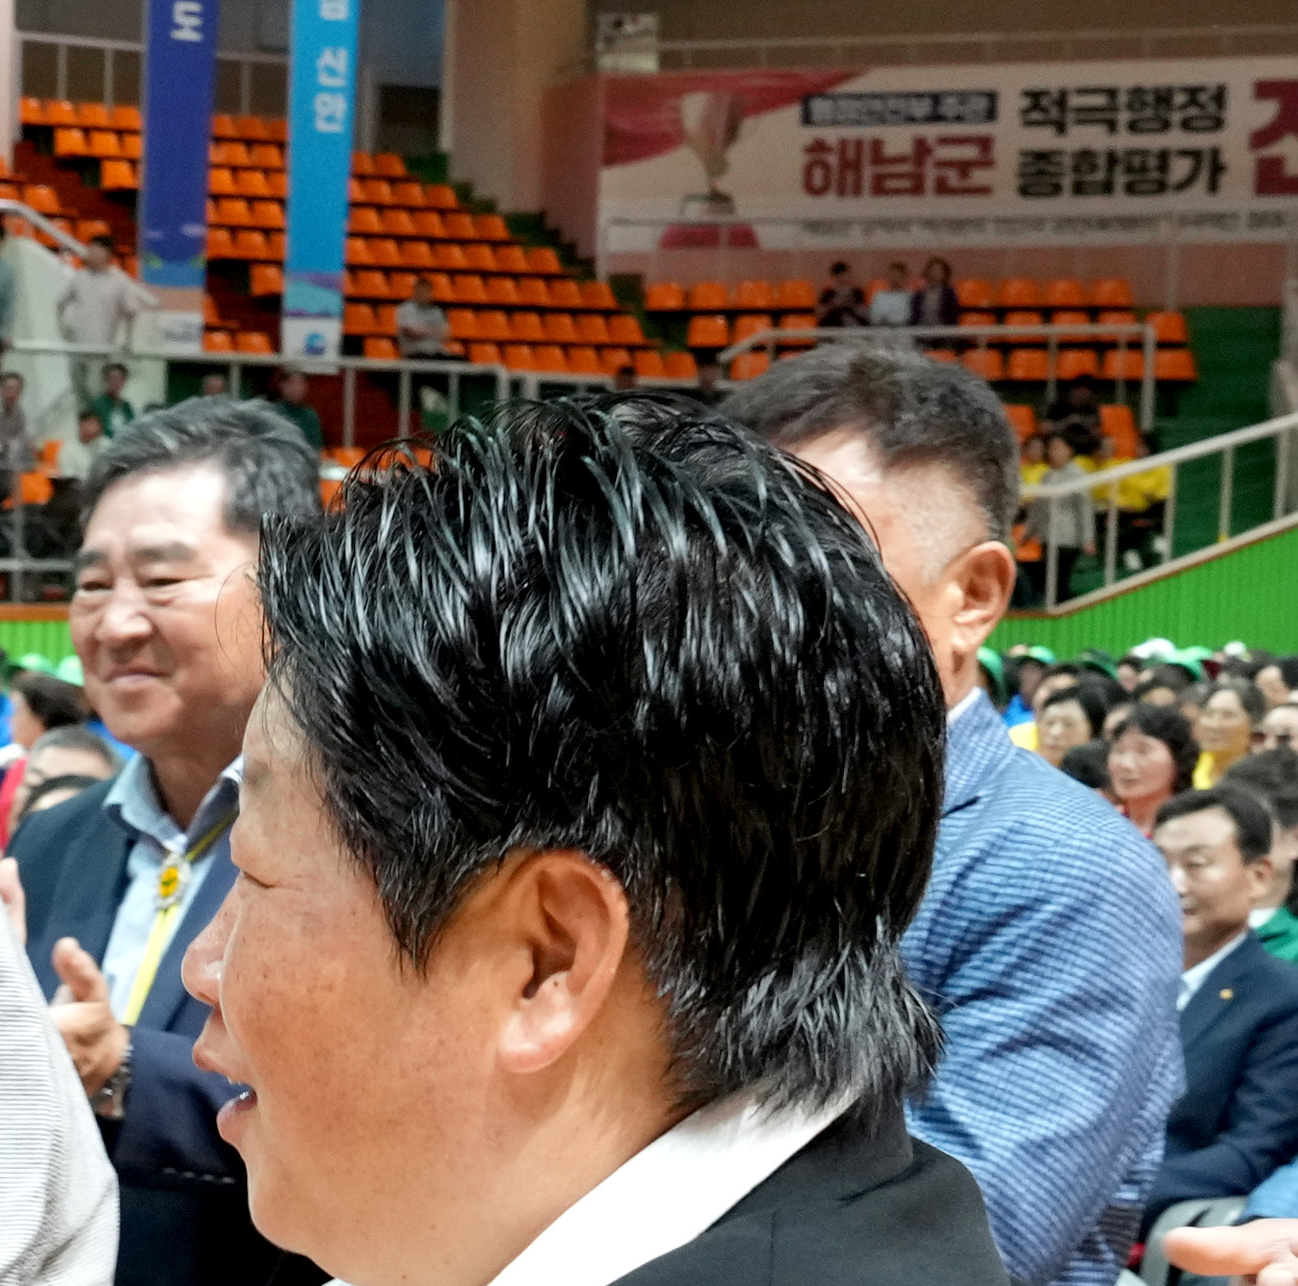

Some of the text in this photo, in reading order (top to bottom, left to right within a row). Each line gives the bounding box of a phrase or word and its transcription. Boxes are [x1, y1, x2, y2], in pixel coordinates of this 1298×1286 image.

[314, 45, 349, 134] 신안
[1020, 81, 1228, 137] 적극행정
[802, 133, 996, 197] 해남군
[1017, 145, 1228, 198] 종합평가
